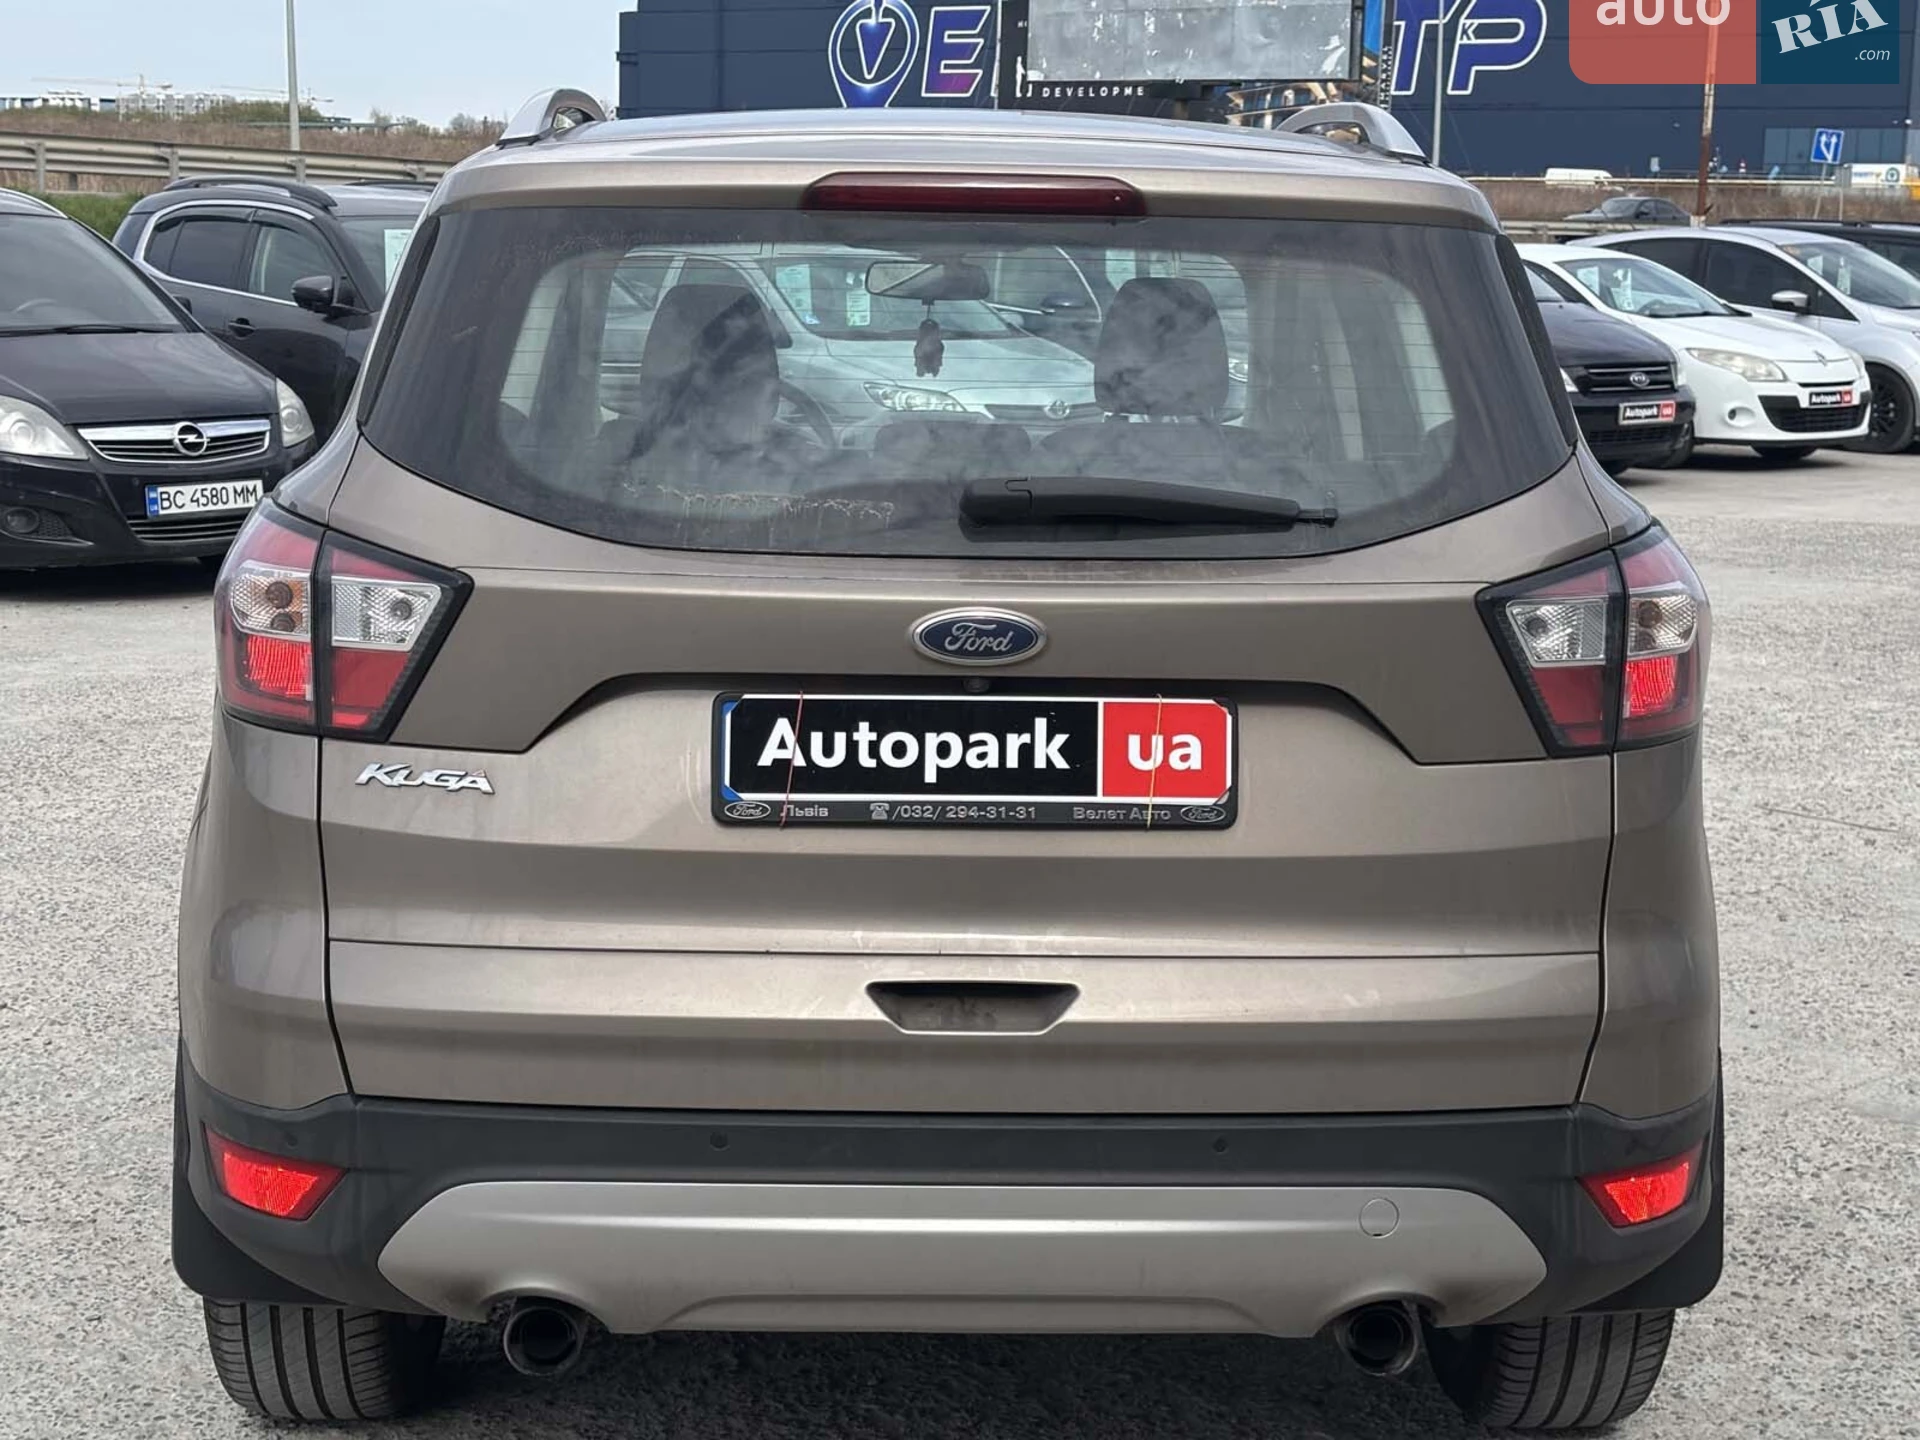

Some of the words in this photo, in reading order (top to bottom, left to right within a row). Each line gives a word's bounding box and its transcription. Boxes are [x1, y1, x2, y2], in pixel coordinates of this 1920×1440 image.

[1042, 86, 1145, 98] DEVELOPME
[160, 490, 186, 511] BC
[190, 486, 230, 508] 4580
[233, 483, 259, 504] MM
[944, 622, 1014, 652] Ford
[757, 716, 1071, 784] Autopark
[1127, 733, 1203, 771] ua
[355, 762, 495, 794] KUGA
[732, 802, 763, 817] Ford
[780, 804, 829, 817] Львів
[945, 804, 1036, 819] 294-31-31
[1072, 806, 1125, 820] Велет
[1129, 807, 1172, 821] Авто
